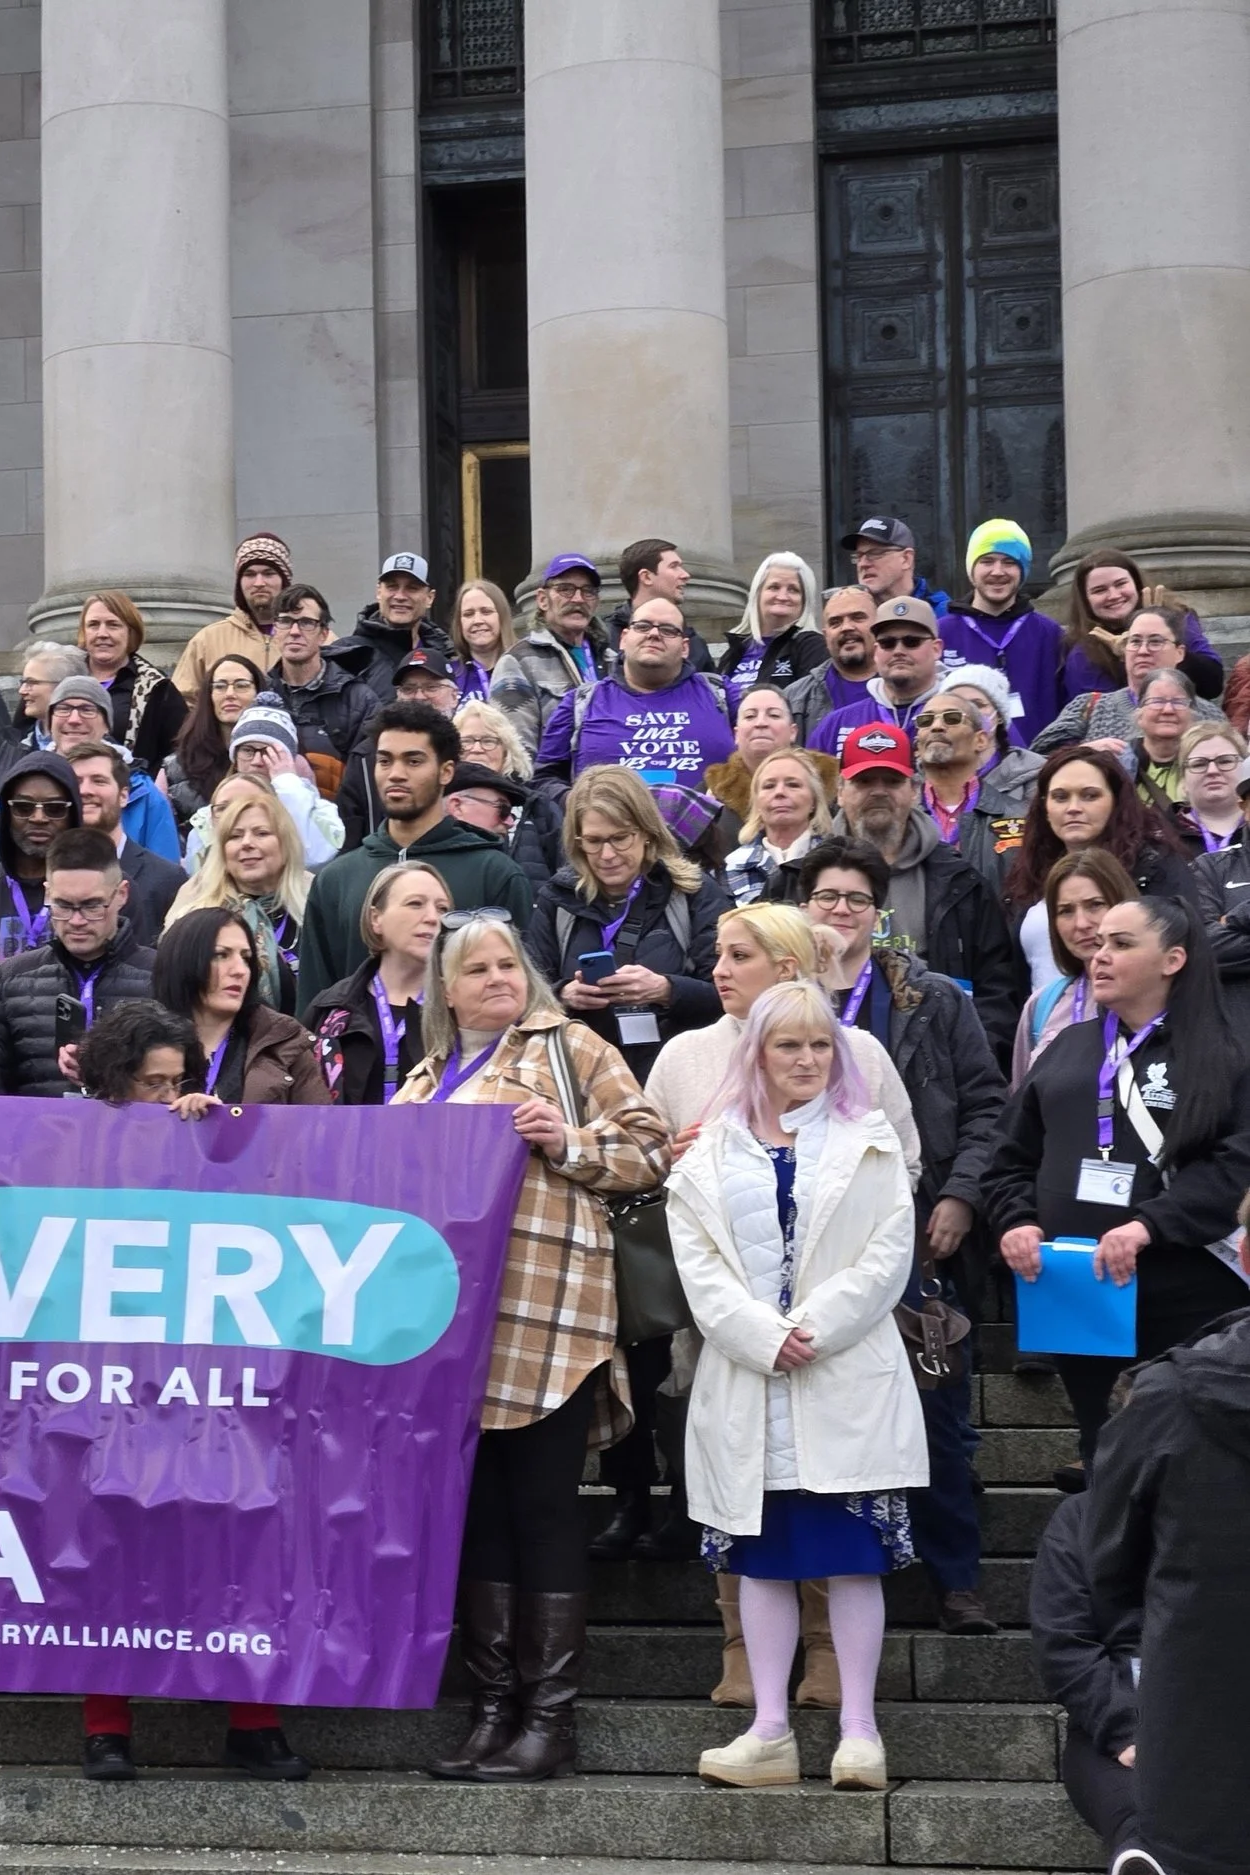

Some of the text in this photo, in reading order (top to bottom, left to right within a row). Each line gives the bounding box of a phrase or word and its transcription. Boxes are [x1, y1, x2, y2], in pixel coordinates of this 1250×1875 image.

[625, 711, 691, 726] SAVE
[632, 725, 684, 740] LIVES
[619, 740, 701, 755] VOTE
[667, 757, 704, 771] YES
[9, 1361, 134, 1405] FOR
[157, 1366, 270, 1407] ALL
